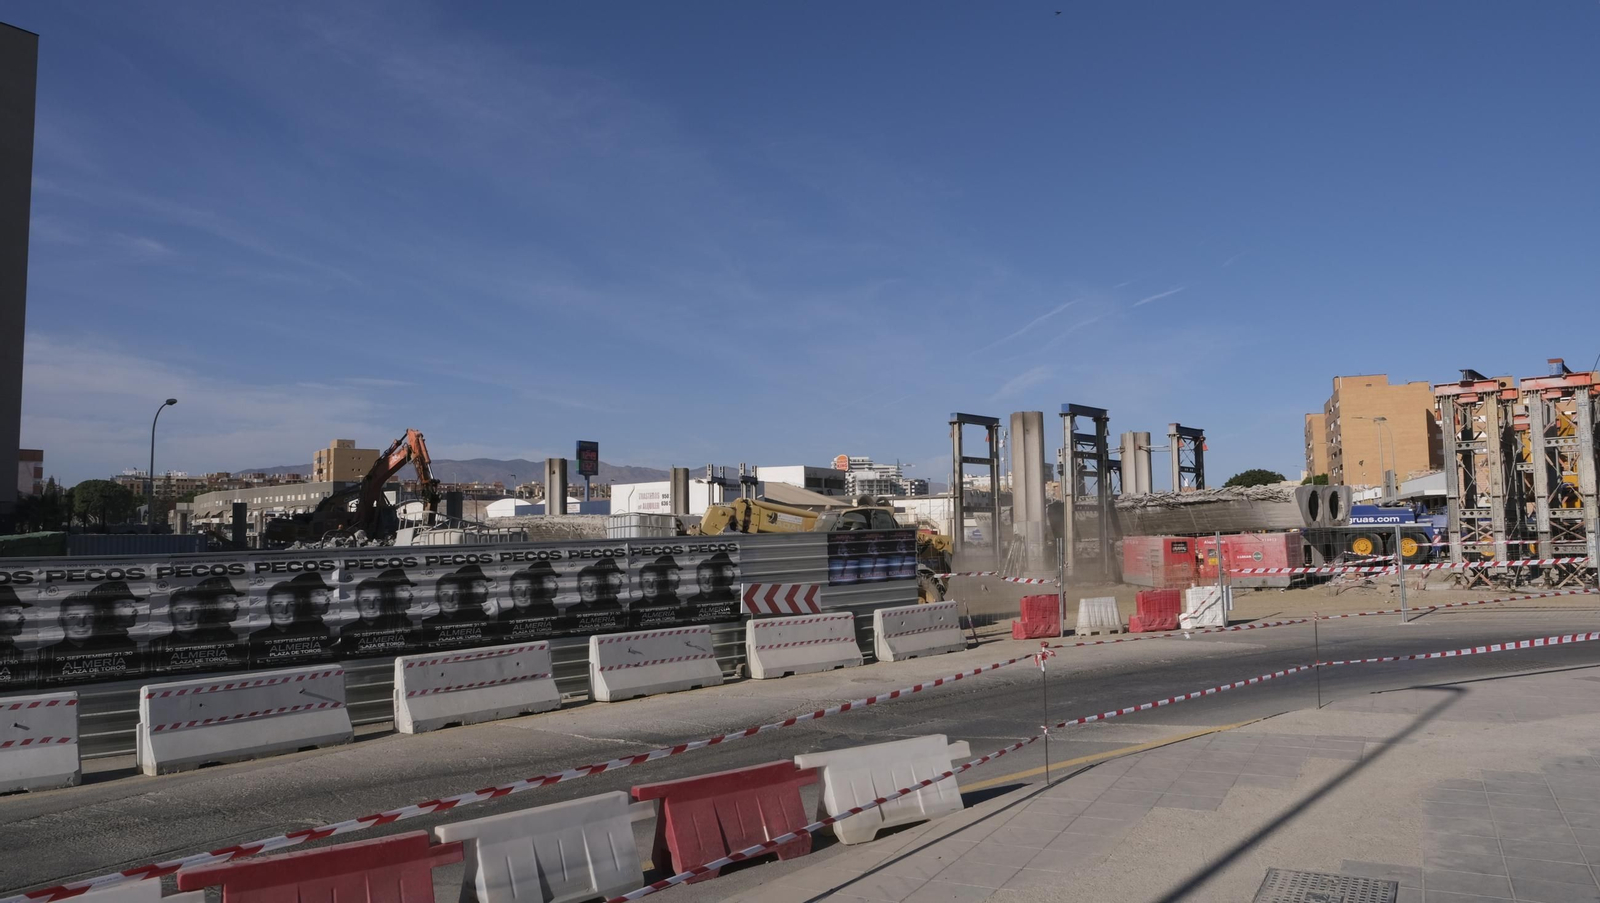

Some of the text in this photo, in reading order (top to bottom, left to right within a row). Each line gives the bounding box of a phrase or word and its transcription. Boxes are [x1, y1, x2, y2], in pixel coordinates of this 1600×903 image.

[568, 548, 625, 560] PECOS
[630, 545, 684, 556] PECOS
[688, 543, 738, 554] PECOS
[425, 554, 493, 566] PECOS
[500, 550, 562, 562] PECOS
[254, 560, 335, 574] PECOS
[344, 557, 418, 570] PECOS
[46, 568, 146, 583] PECOS
[156, 563, 246, 579] PECOS
[0, 571, 34, 584] OS
[579, 614, 615, 624] ALMERÍA
[641, 608, 675, 619] ALMERÍA
[513, 620, 552, 630] ALMERÍA
[439, 627, 482, 637] ALMERÍA
[358, 633, 405, 645] ALMERÍA
[270, 641, 321, 652] ALMERÍA
[171, 648, 228, 660] ALMERÍA
[62, 656, 126, 670] ALMERÍA
